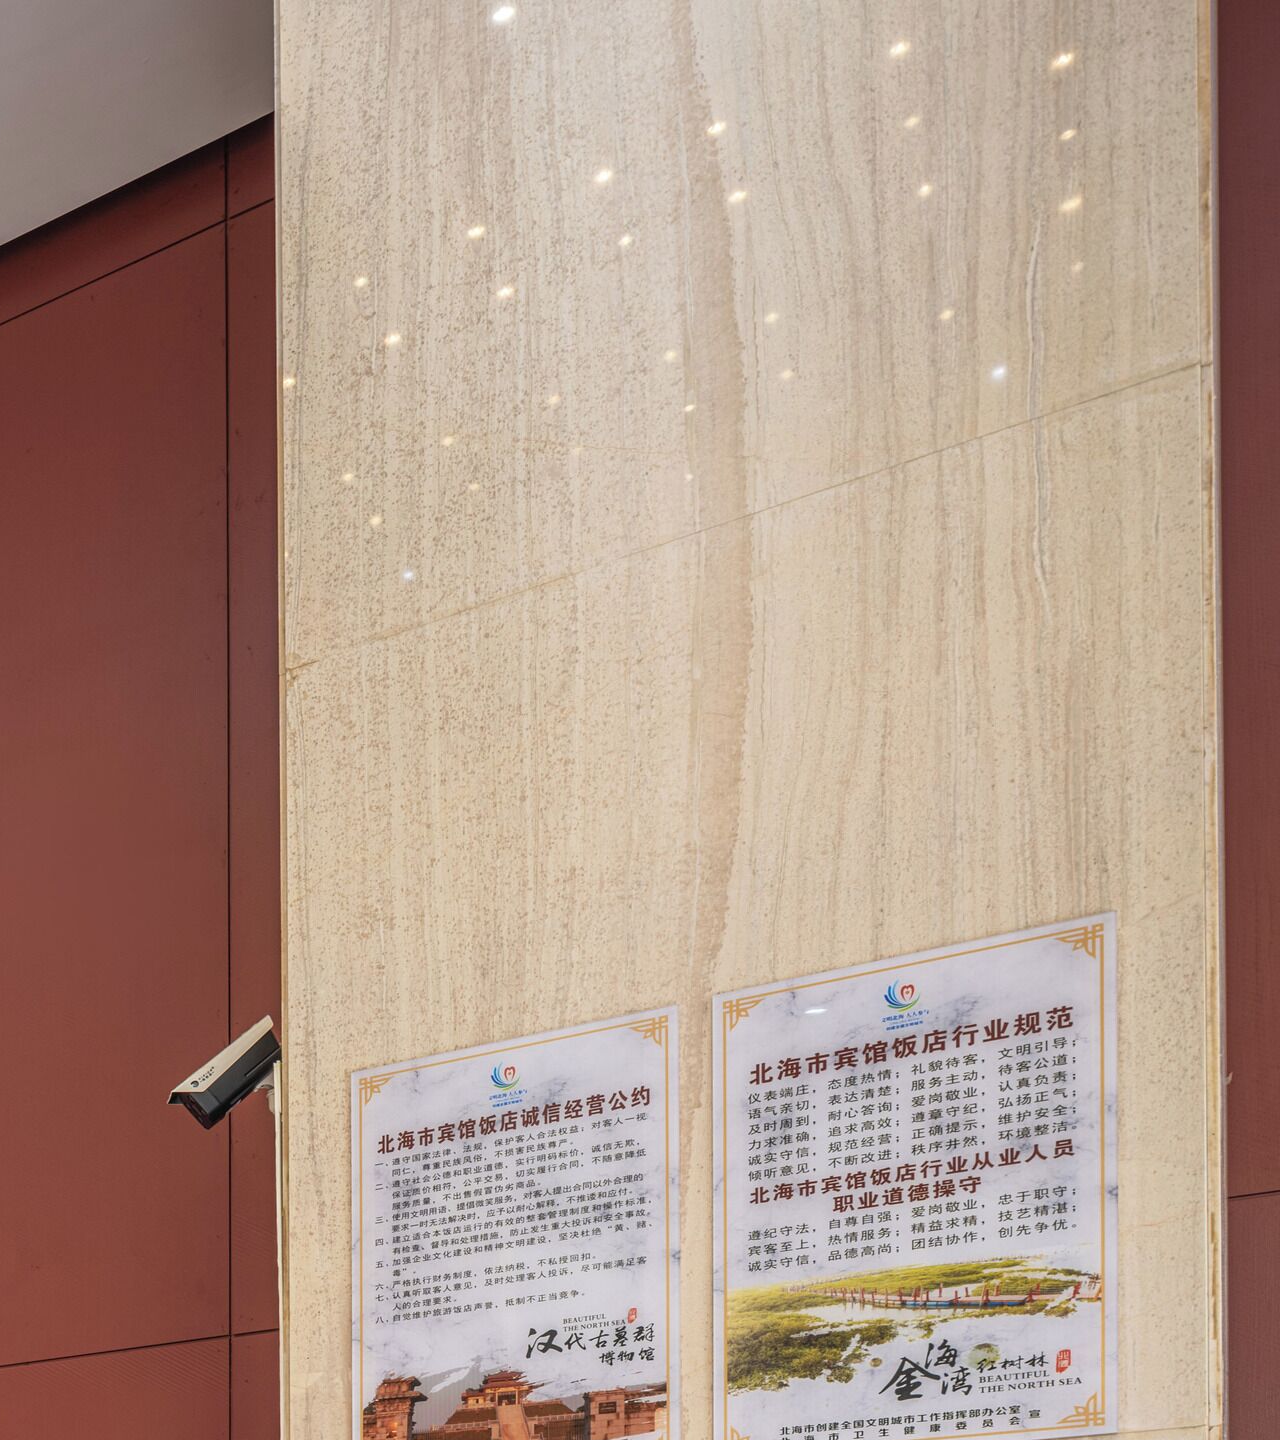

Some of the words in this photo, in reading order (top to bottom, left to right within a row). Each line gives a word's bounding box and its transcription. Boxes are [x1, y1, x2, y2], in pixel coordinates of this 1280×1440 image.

[750, 1003, 1074, 1086] 北海市宾馆饭店行业规范
[376, 1083, 651, 1156] 北海市宾馆饭店诚信经营公约
[749, 1137, 1075, 1205] 北海市宾馆饭店行业从业人员
[832, 1174, 982, 1214] 职业道德操守
[561, 1312, 607, 1325] BEAUTIFUL
[563, 1324, 579, 1333] THE
[580, 1320, 609, 1330] NORTH
[610, 1318, 626, 1327] SEA
[526, 1322, 656, 1359] 汉代古墓群
[598, 1345, 656, 1367] 博物馆
[976, 1350, 1050, 1373] 红树林
[978, 1368, 1050, 1384] BEAUTIFUL
[978, 1383, 1004, 1395] THE
[1007, 1378, 1055, 1392] NORTH
[1058, 1375, 1083, 1387] SEA
[778, 1403, 1021, 1437] 北海市创建全国文明城市工作指挥部办公室
